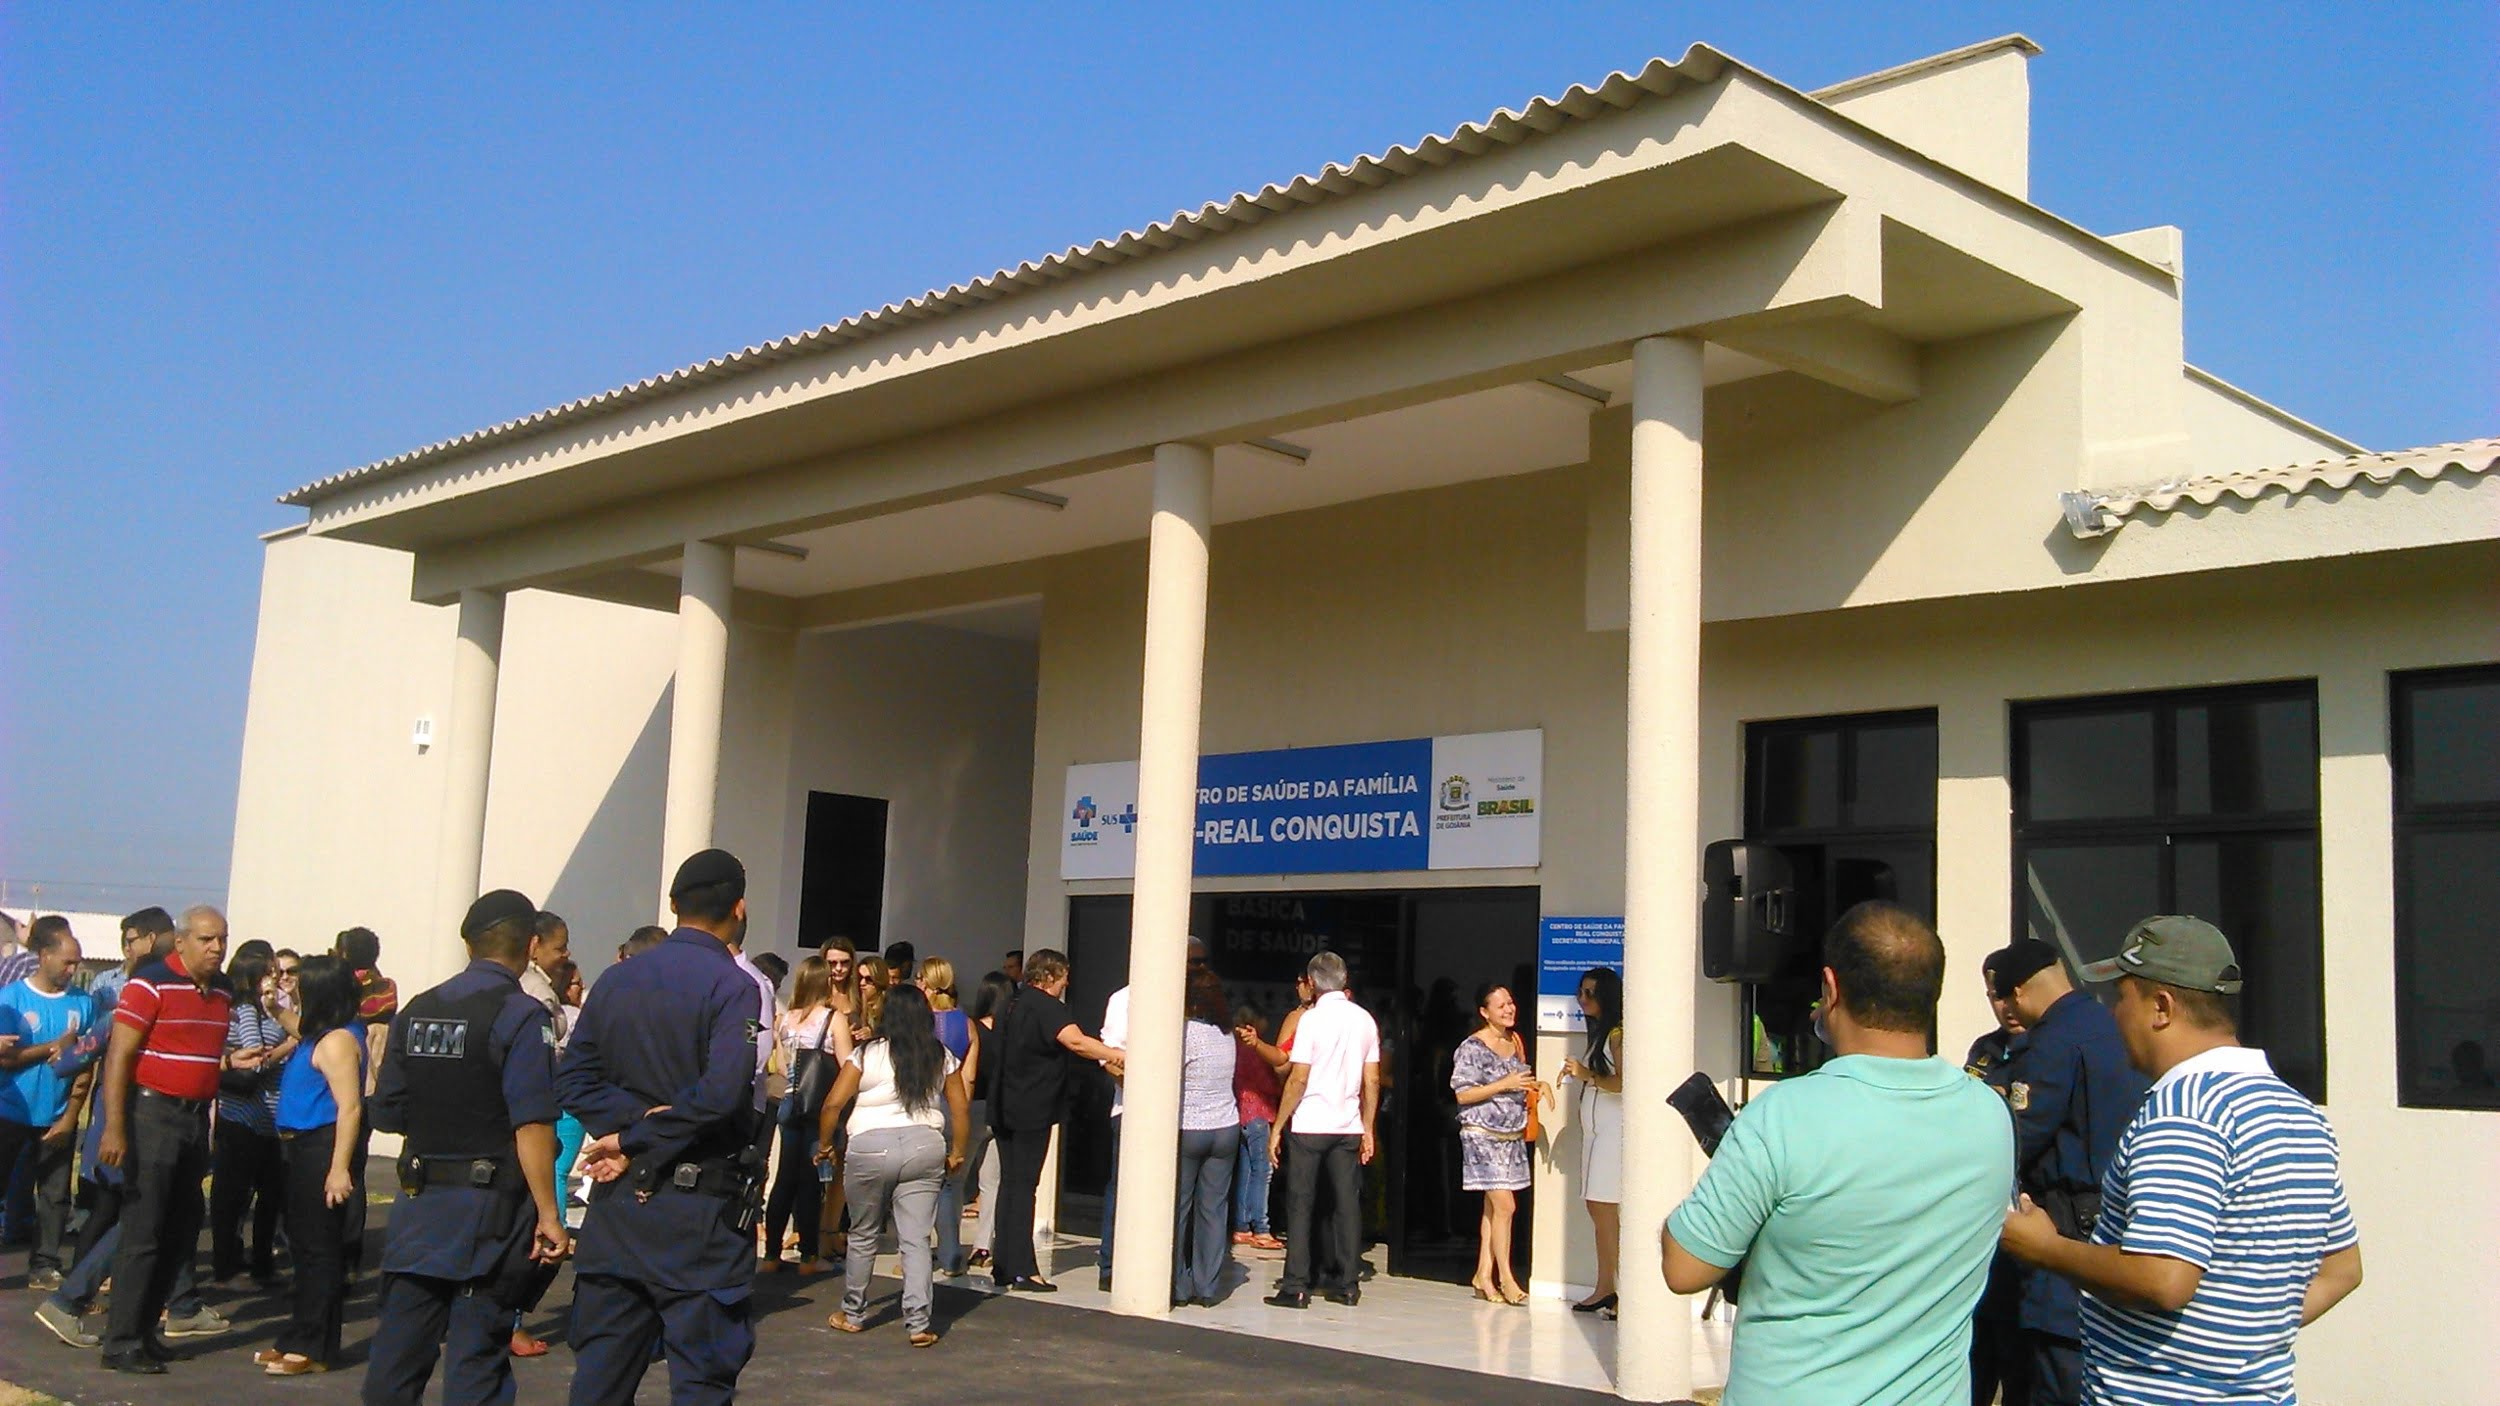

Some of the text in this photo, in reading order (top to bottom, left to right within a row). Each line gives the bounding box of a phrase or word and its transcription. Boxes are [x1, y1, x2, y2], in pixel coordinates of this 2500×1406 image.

[1196, 772, 1418, 804] RO DE SAÚDE DA FAMÍLIA
[1477, 798, 1534, 815] BRASIL
[1101, 814, 1118, 825] SUS
[1270, 810, 1420, 842] CONQUISTA
[1071, 831, 1098, 842] SAÚDE
[1226, 928, 1255, 951] DE
